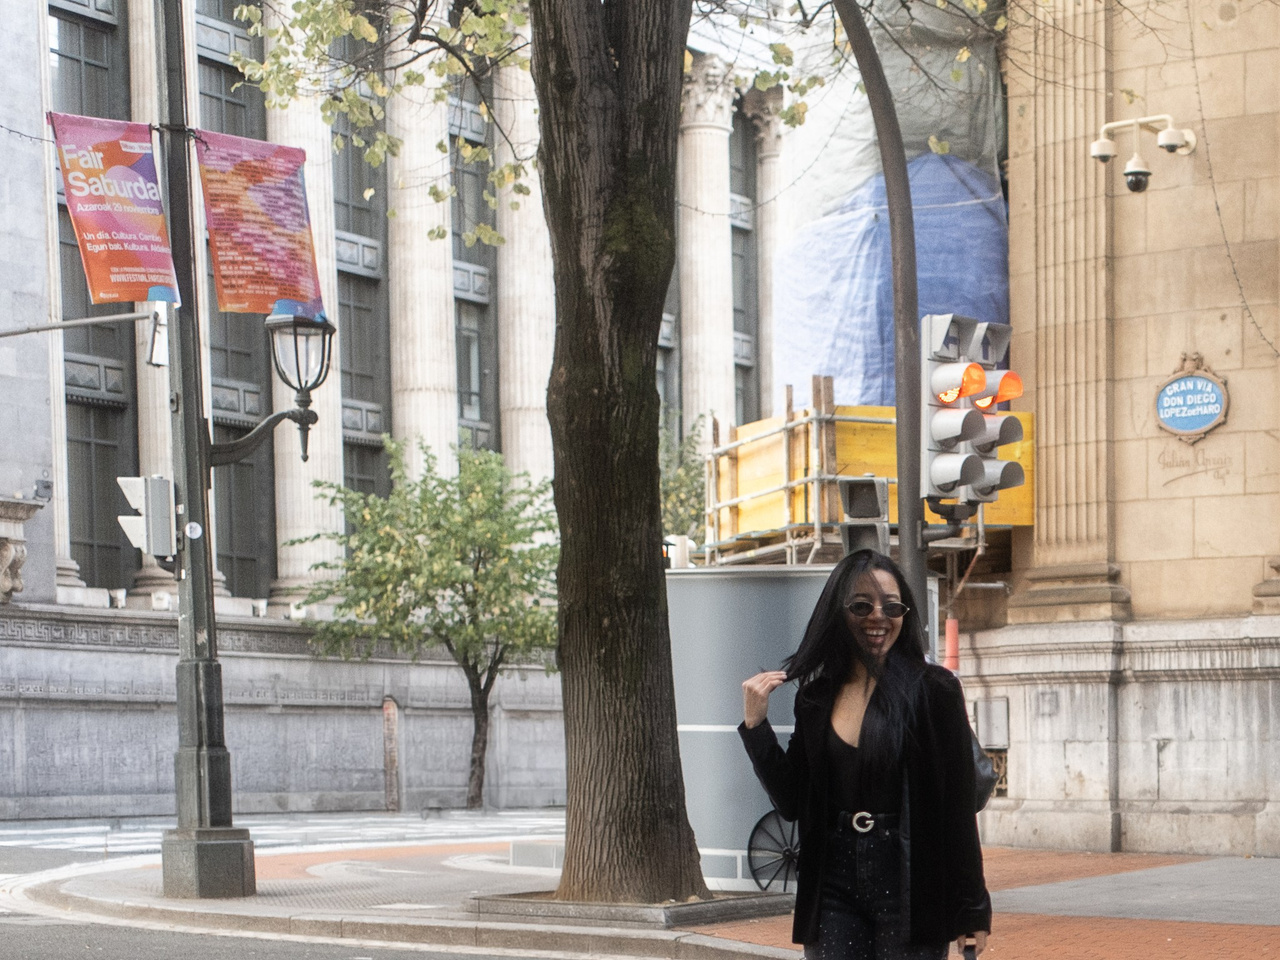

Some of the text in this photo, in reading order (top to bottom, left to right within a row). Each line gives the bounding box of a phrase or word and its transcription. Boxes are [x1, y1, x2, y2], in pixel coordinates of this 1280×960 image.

[61, 144, 104, 169] Fair
[68, 171, 162, 201] Saturda
[77, 203, 111, 212] Azaroak
[123, 205, 160, 215] noviembre
[83, 232, 95, 240] Un
[86, 243, 108, 253] Egun
[1165, 380, 1213, 396] GRAN VIA
[1163, 393, 1217, 407] DON DIEGO
[1159, 407, 1188, 418] LOPEZ
[1197, 404, 1221, 415] HARO
[852, 811, 875, 833] G
